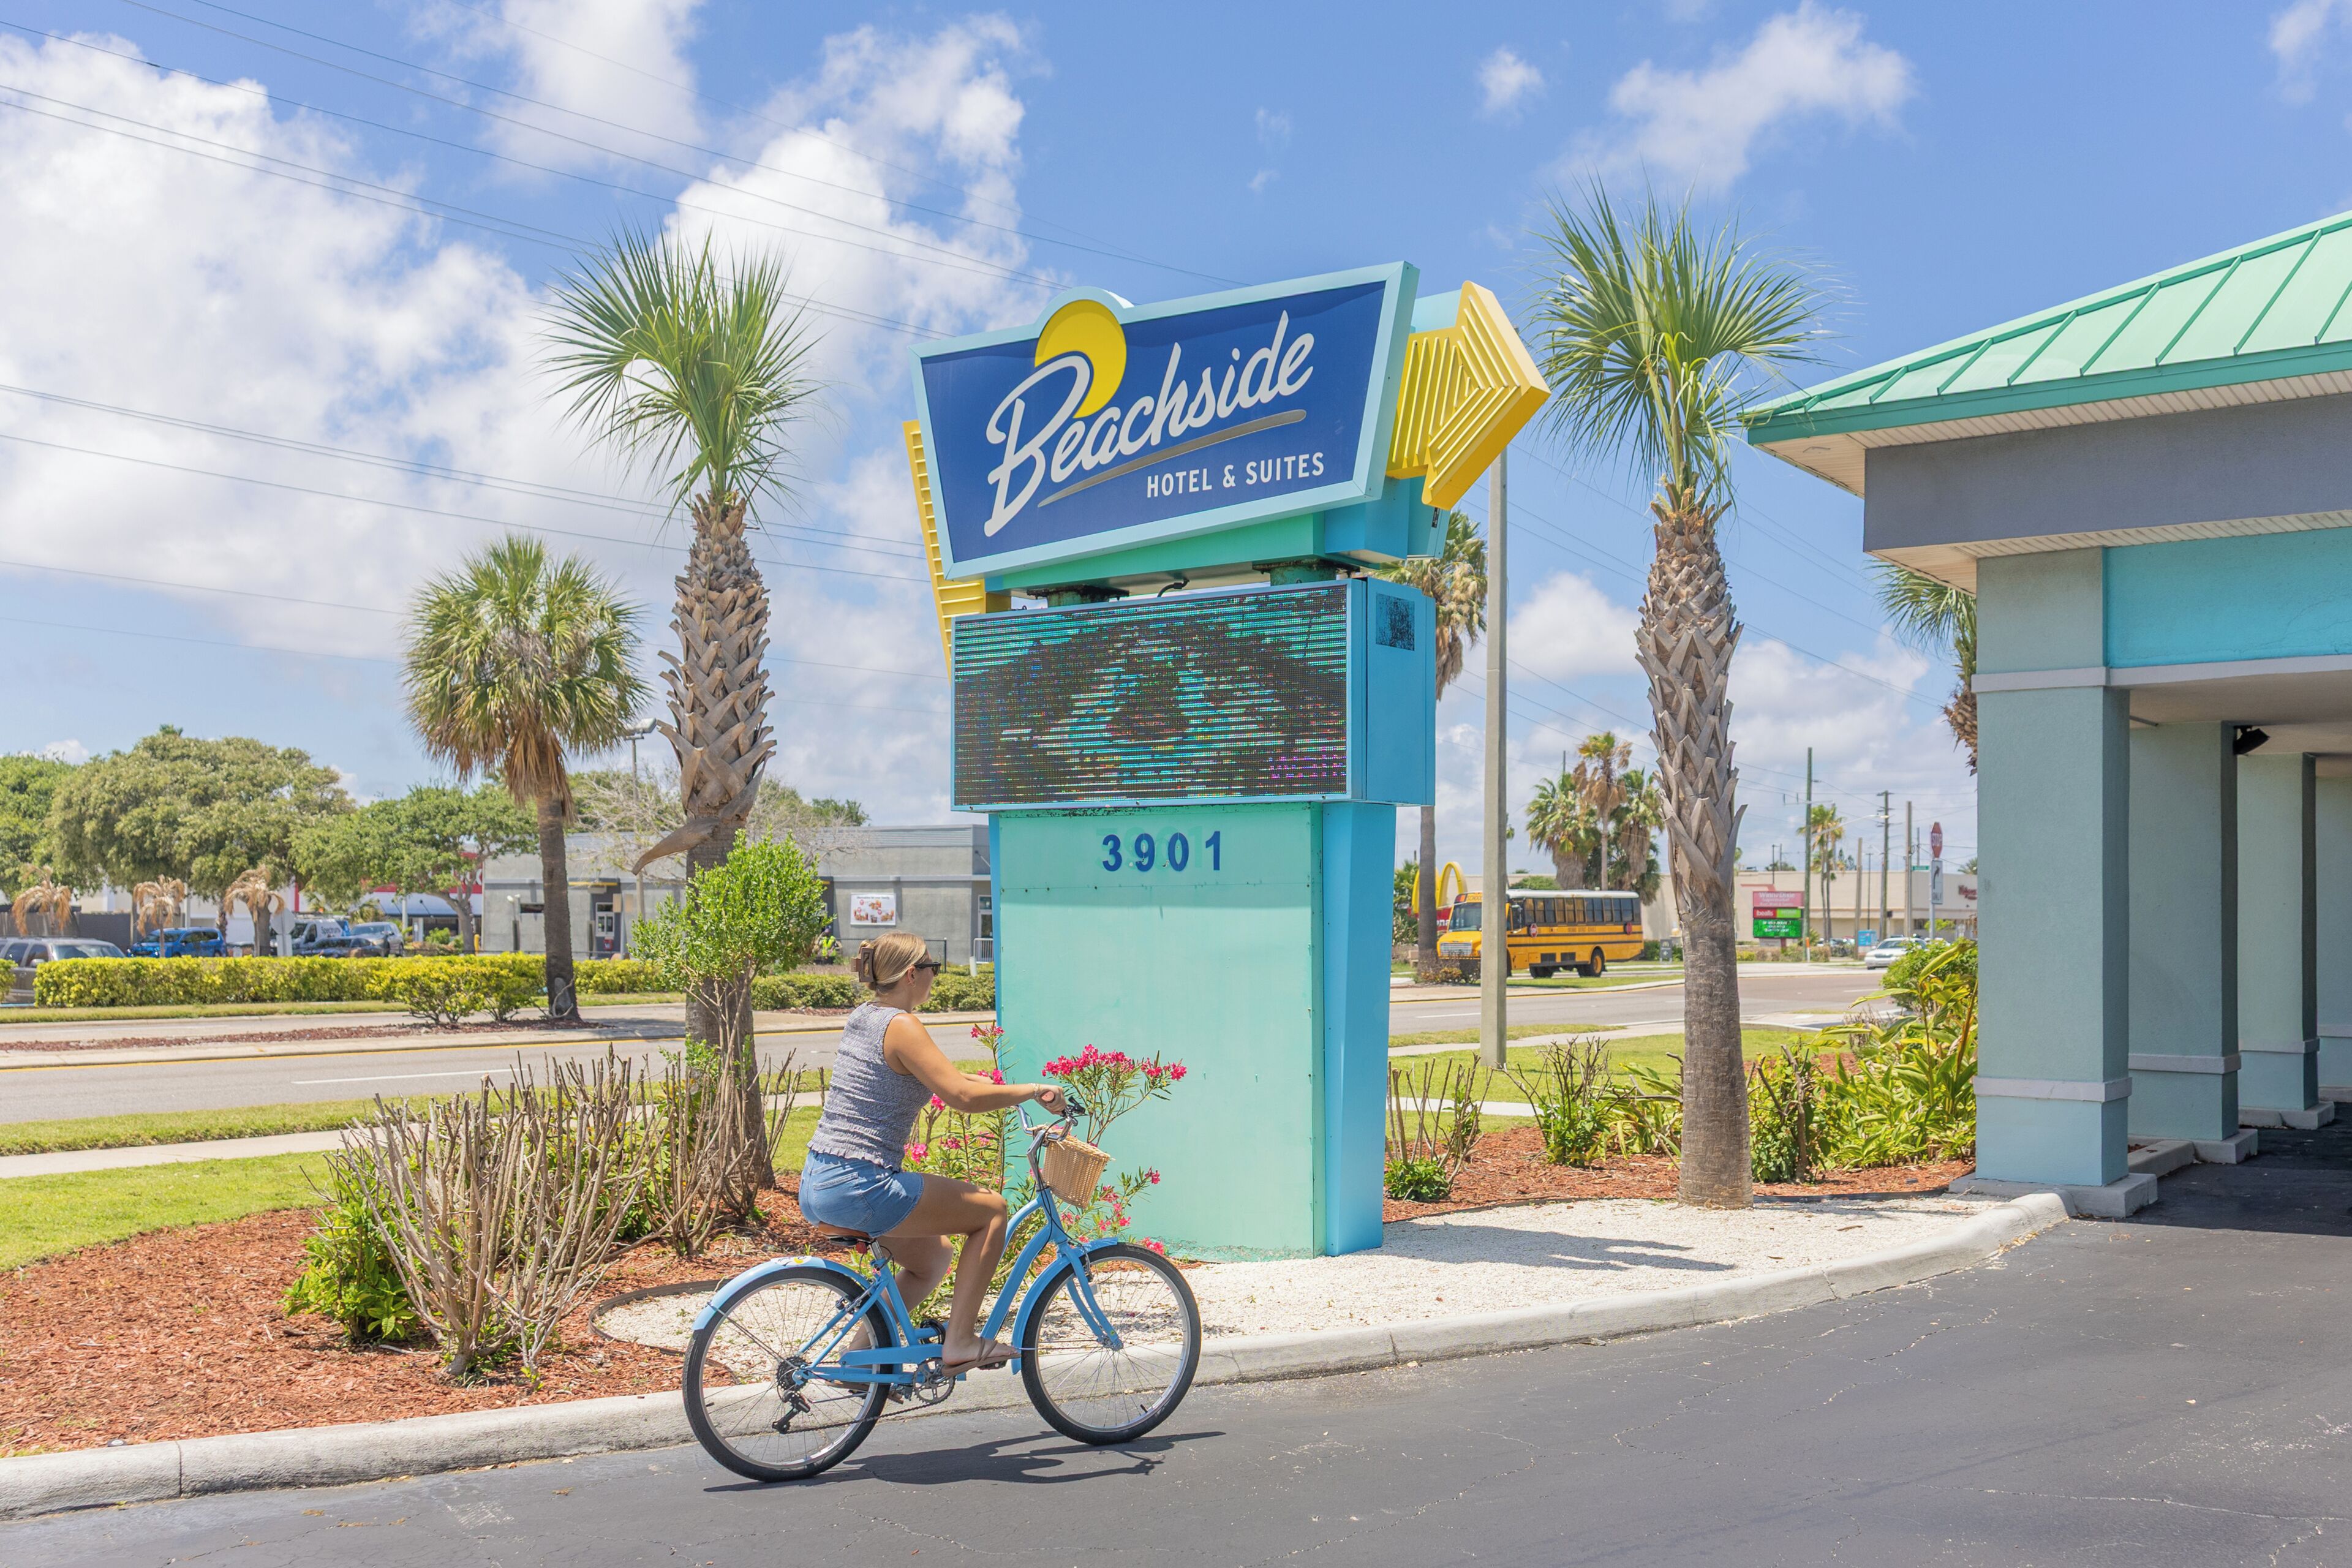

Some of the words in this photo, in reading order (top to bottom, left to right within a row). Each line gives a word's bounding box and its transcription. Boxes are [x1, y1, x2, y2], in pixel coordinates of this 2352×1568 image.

[984, 310, 1314, 537] Beachside
[1147, 468, 1212, 498] HOTEL
[1222, 464, 1236, 488] &
[1245, 451, 1324, 485] SUITES
[1102, 831, 1221, 872] 3901
[1931, 833, 1942, 846] STOP
[1932, 892, 1942, 901] ONLY
